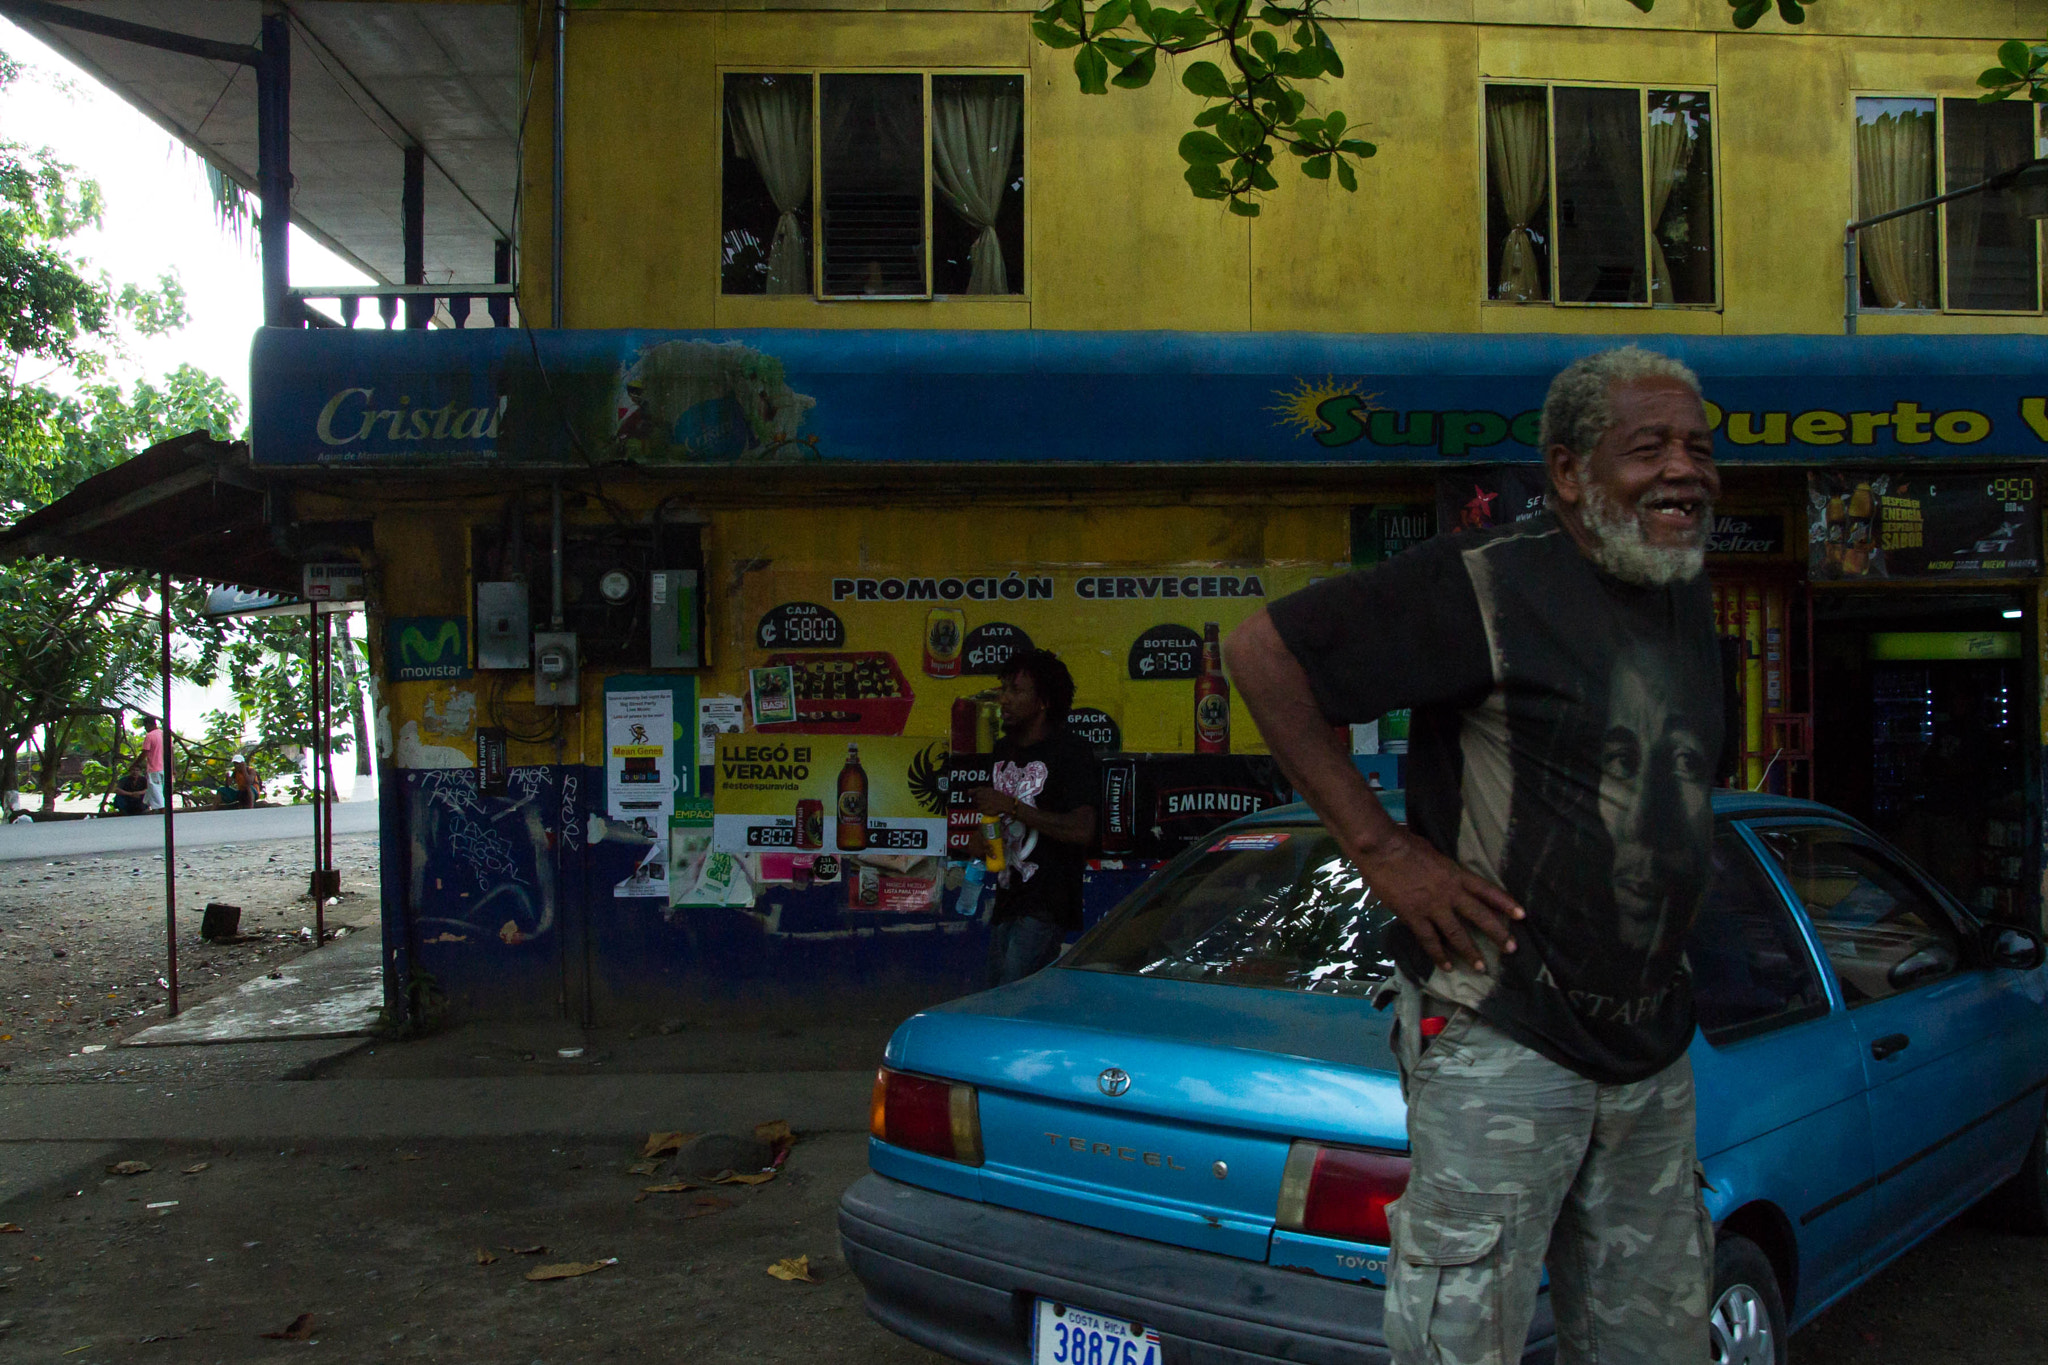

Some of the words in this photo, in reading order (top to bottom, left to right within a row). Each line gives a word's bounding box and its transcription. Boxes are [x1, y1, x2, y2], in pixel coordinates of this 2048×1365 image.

[316, 387, 508, 446] Cristal
[1311, 393, 1541, 457] Supe
[1705, 533, 1776, 551] Seltzer
[326, 567, 362, 578] NACIO
[832, 571, 1053, 601] PROMOCIÓN
[1075, 575, 1266, 600] CERVECERA
[786, 606, 818, 615] CAJA
[981, 627, 1013, 637] LATA
[1143, 639, 1198, 649] BOTELLA
[968, 644, 1014, 669] ¢80
[400, 664, 463, 678] movistar
[762, 700, 788, 710] BASH
[1067, 714, 1108, 723] 6PACK
[722, 743, 789, 763] LLEGÓ
[722, 764, 809, 781] VERANO
[722, 781, 799, 792] #estoespuravida
[950, 791, 964, 804] EL
[1109, 774, 1123, 833] SMIRNOFF
[1168, 792, 1263, 814] SMIRNOFF
[675, 810, 714, 820] EMPAQ
[950, 812, 984, 825] SMIR
[1043, 1132, 1186, 1172] TERCEL
[1335, 1254, 1387, 1274] TOYOT
[1068, 1312, 1100, 1329] COSTA
[1104, 1321, 1127, 1337] RICA
